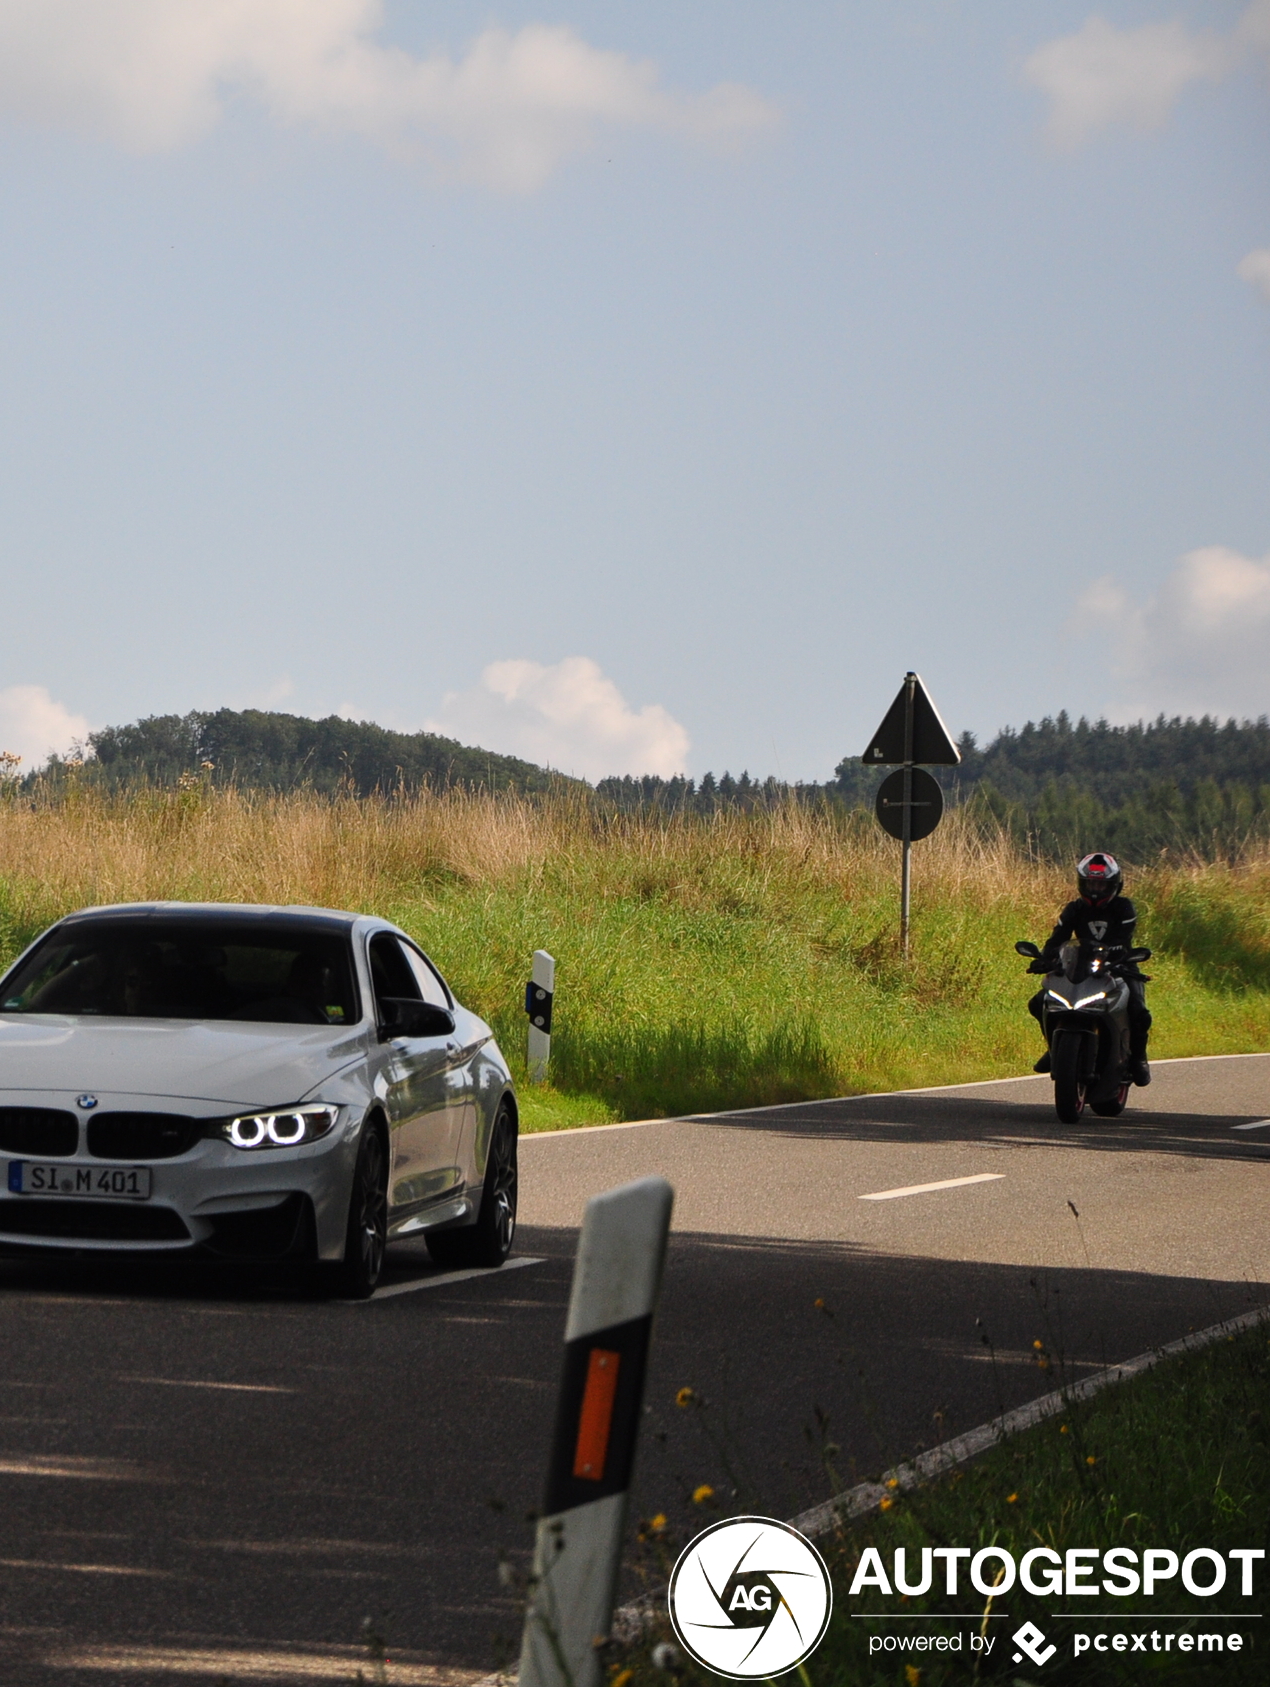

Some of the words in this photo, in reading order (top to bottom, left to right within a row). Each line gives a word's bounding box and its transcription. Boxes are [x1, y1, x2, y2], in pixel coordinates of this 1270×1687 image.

[31, 1167, 59, 1190] SI
[76, 1169, 91, 1191] M
[97, 1170, 140, 1194] 401
